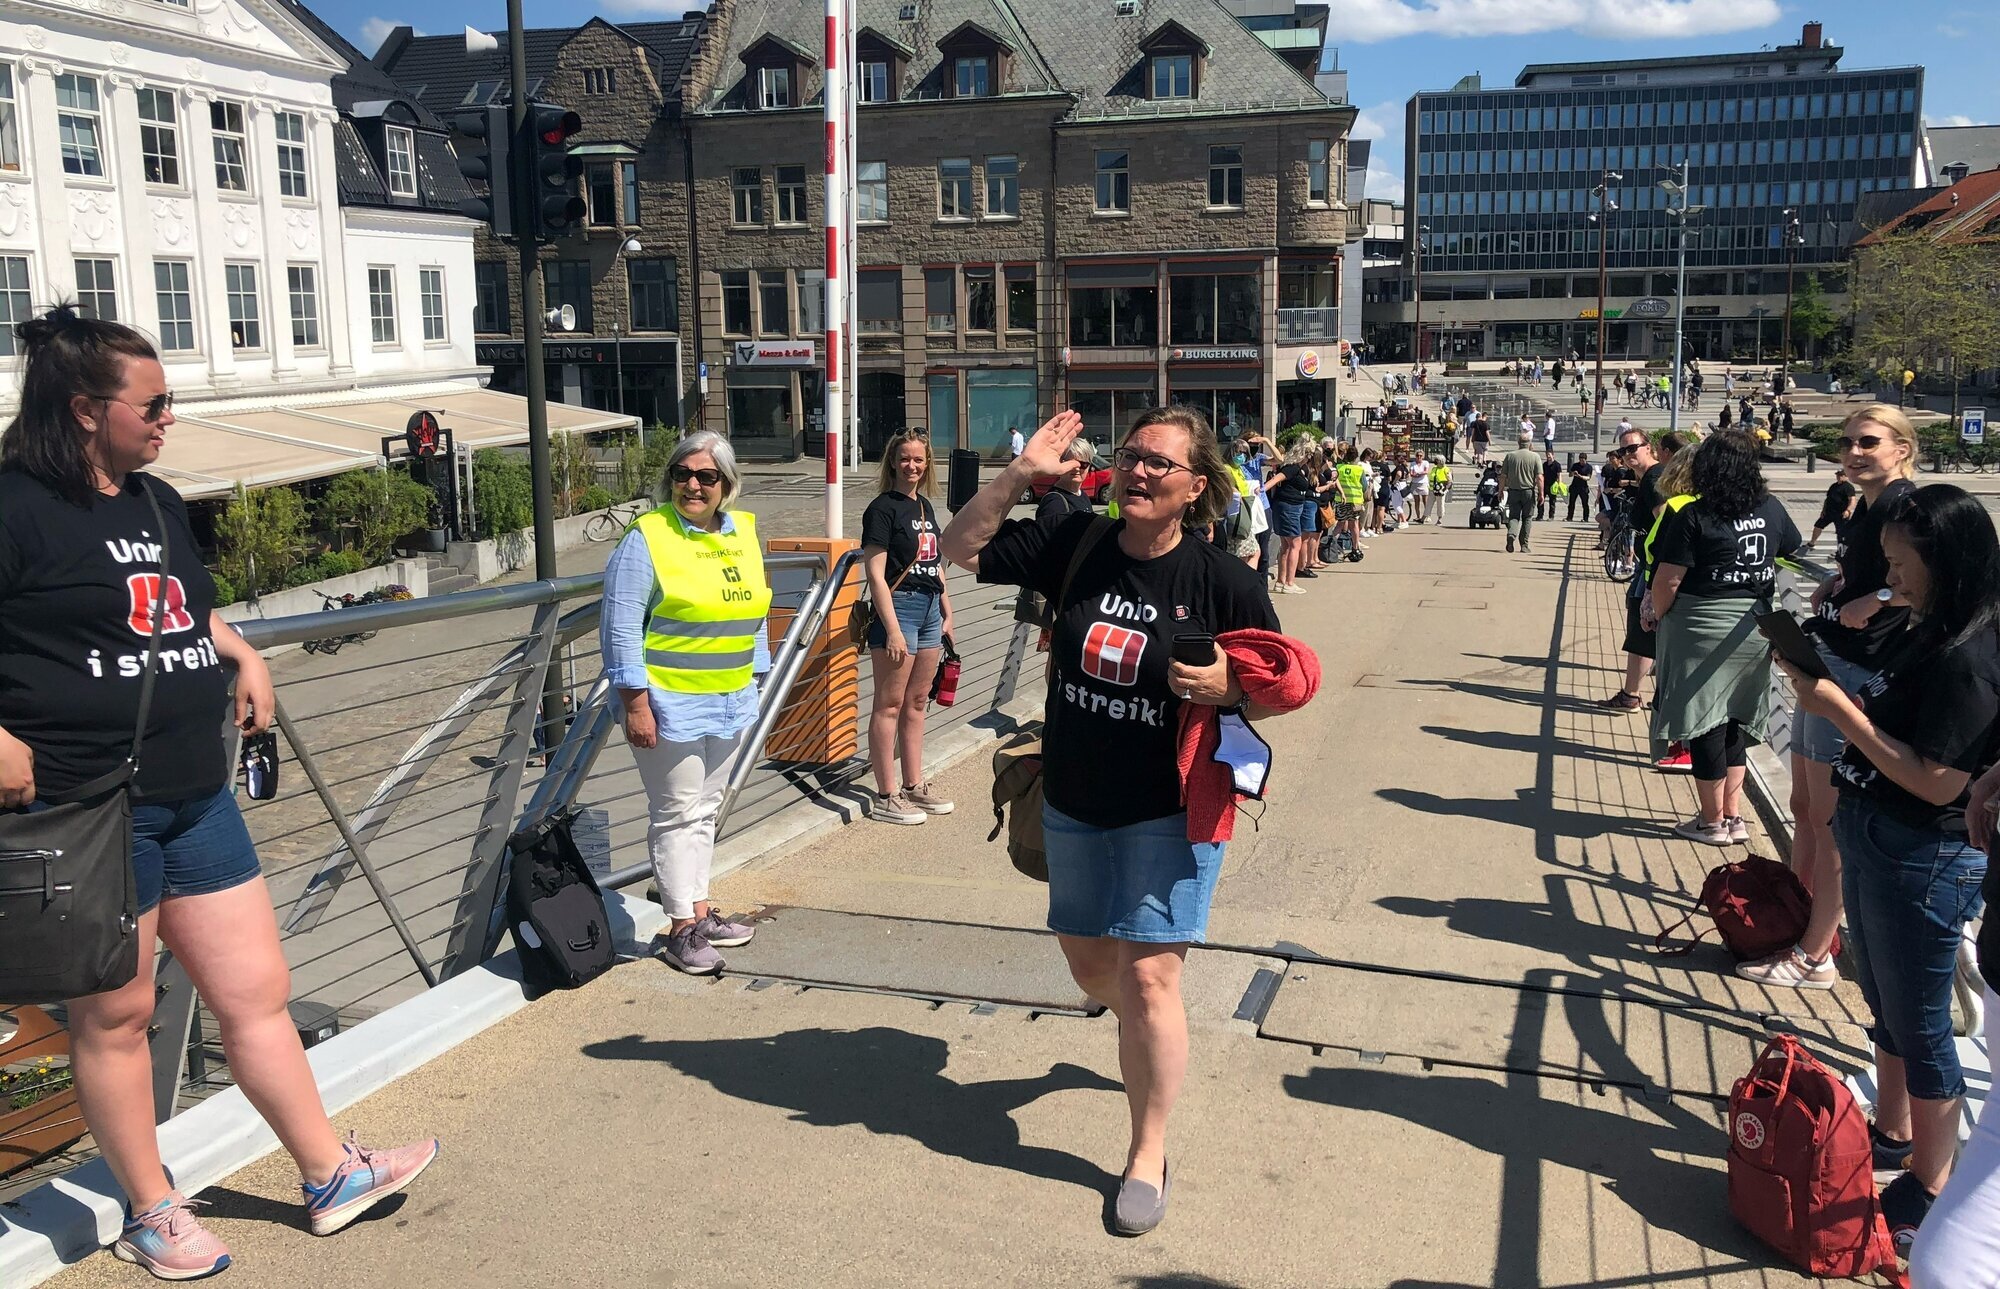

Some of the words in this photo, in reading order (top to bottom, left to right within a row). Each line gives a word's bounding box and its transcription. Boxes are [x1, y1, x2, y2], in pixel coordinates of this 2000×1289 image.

[1635, 304, 1667, 312] FOKUS
[785, 349, 792, 358] &
[793, 349, 811, 358] Grill
[1186, 349, 1230, 359] BURGER
[1231, 349, 1258, 358] KING
[1733, 513, 1766, 532] Unio
[1712, 568, 1719, 581] i
[722, 586, 752, 602] Unio
[1100, 592, 1158, 623] Unio
[87, 649, 103, 677] i
[1065, 682, 1167, 727] streik!
